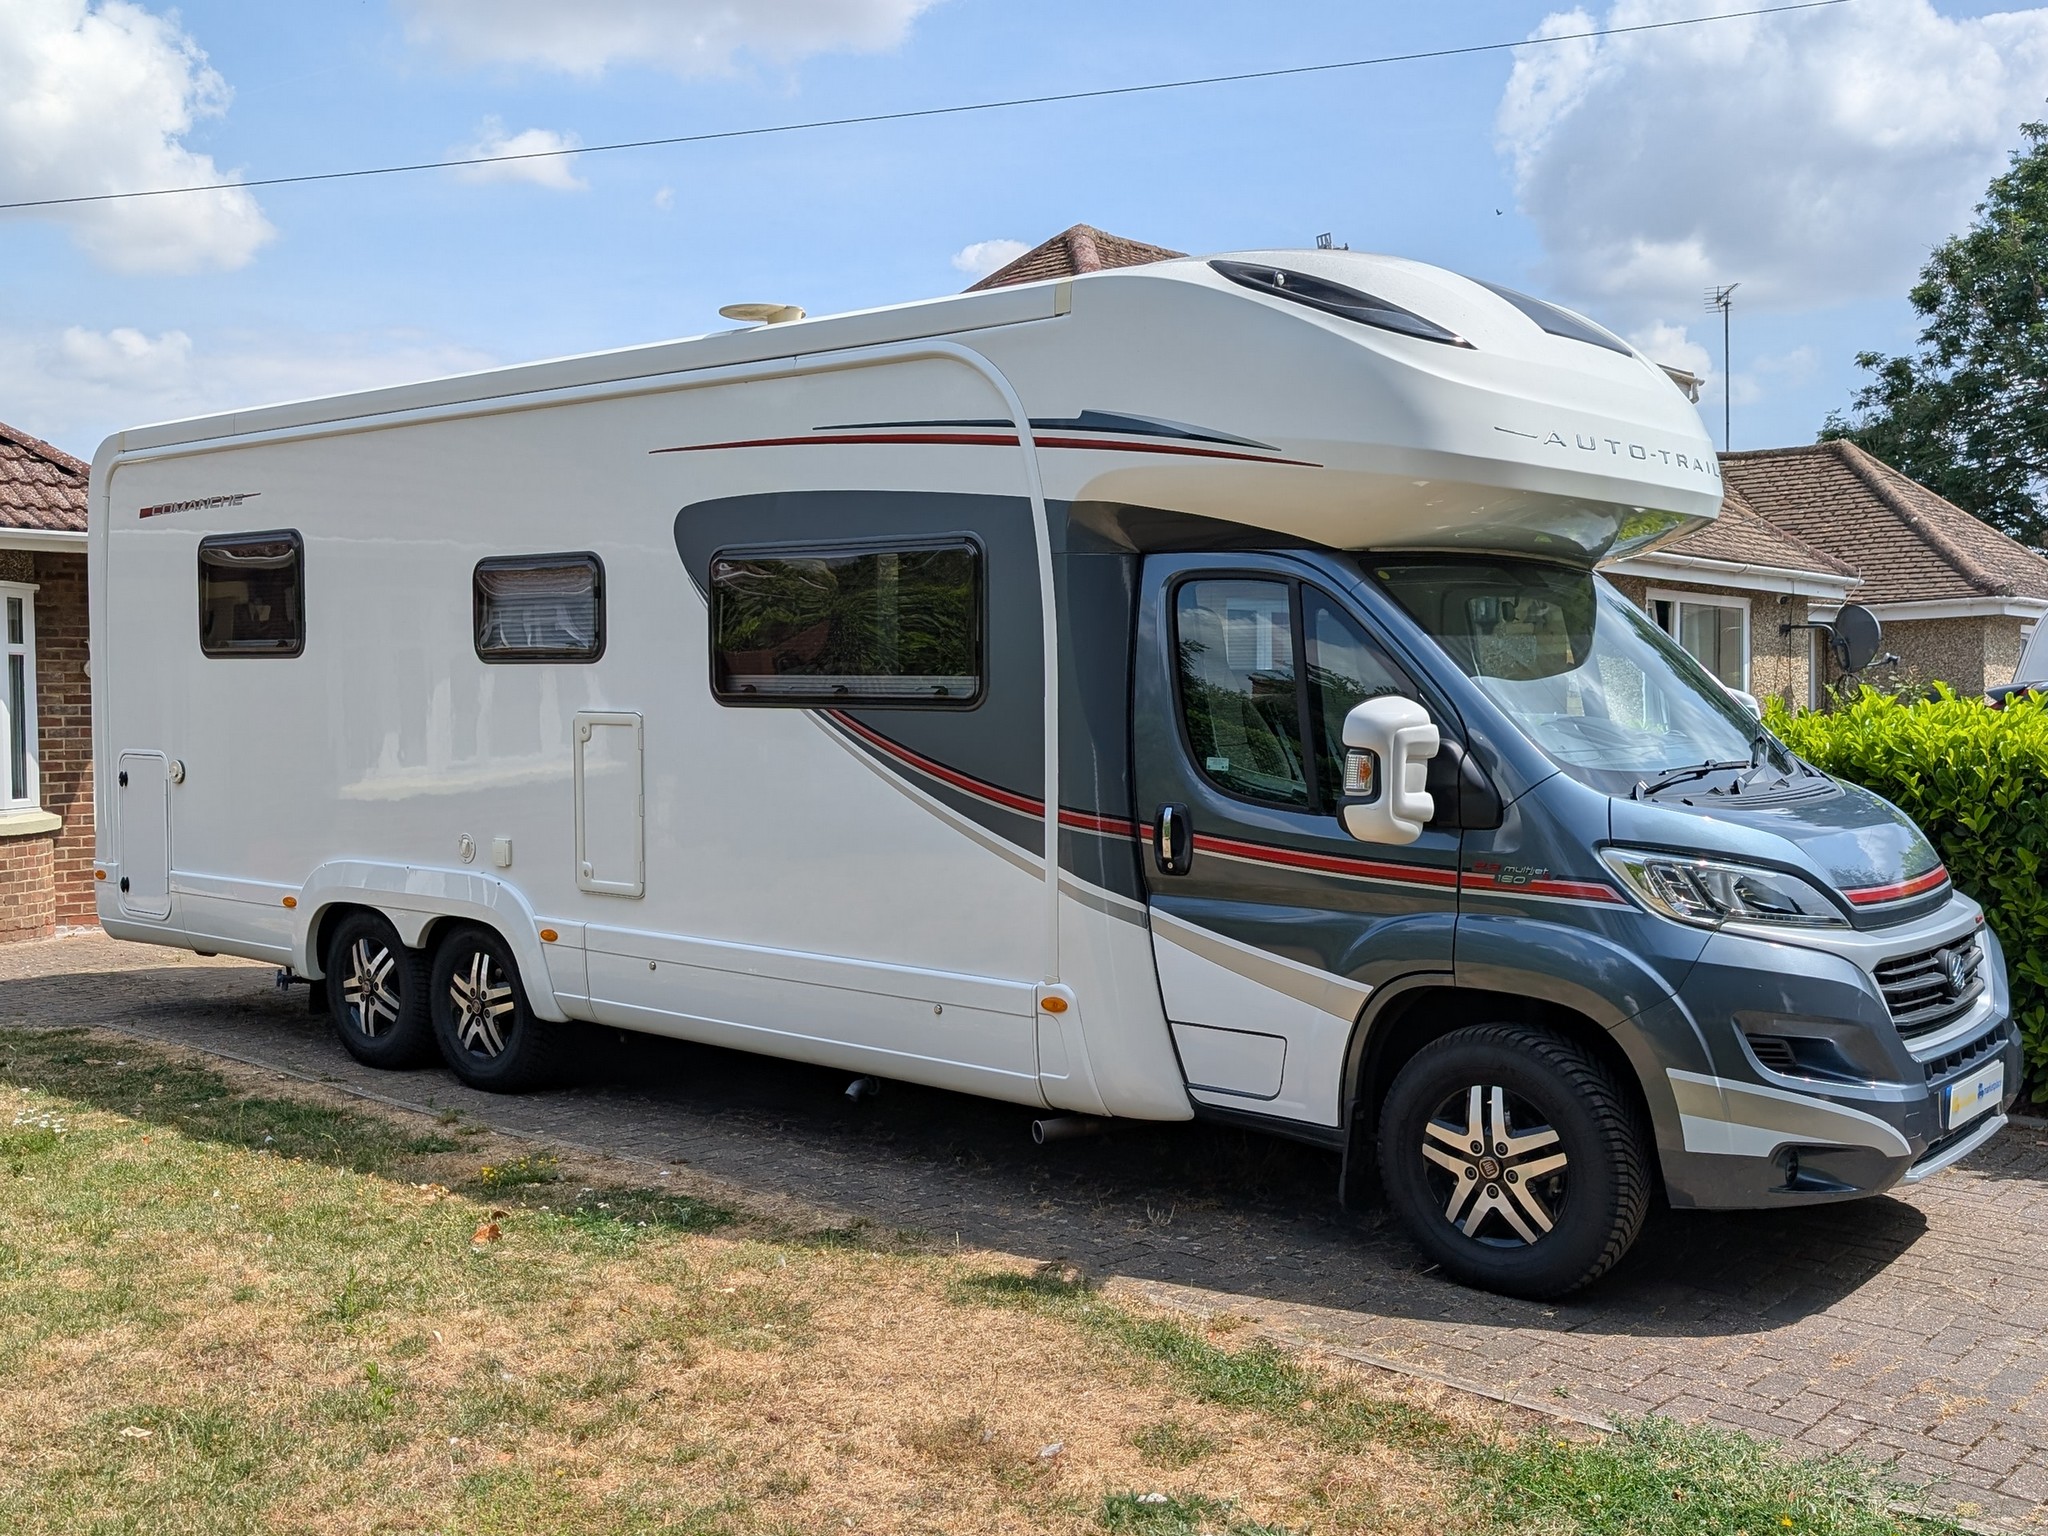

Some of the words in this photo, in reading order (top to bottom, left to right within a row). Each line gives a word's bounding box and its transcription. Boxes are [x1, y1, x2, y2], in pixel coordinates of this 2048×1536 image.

[1543, 431, 1719, 477] AUTO-TRAIL
[151, 494, 243, 516] COMANCHE
[1503, 865, 1549, 876] multijet
